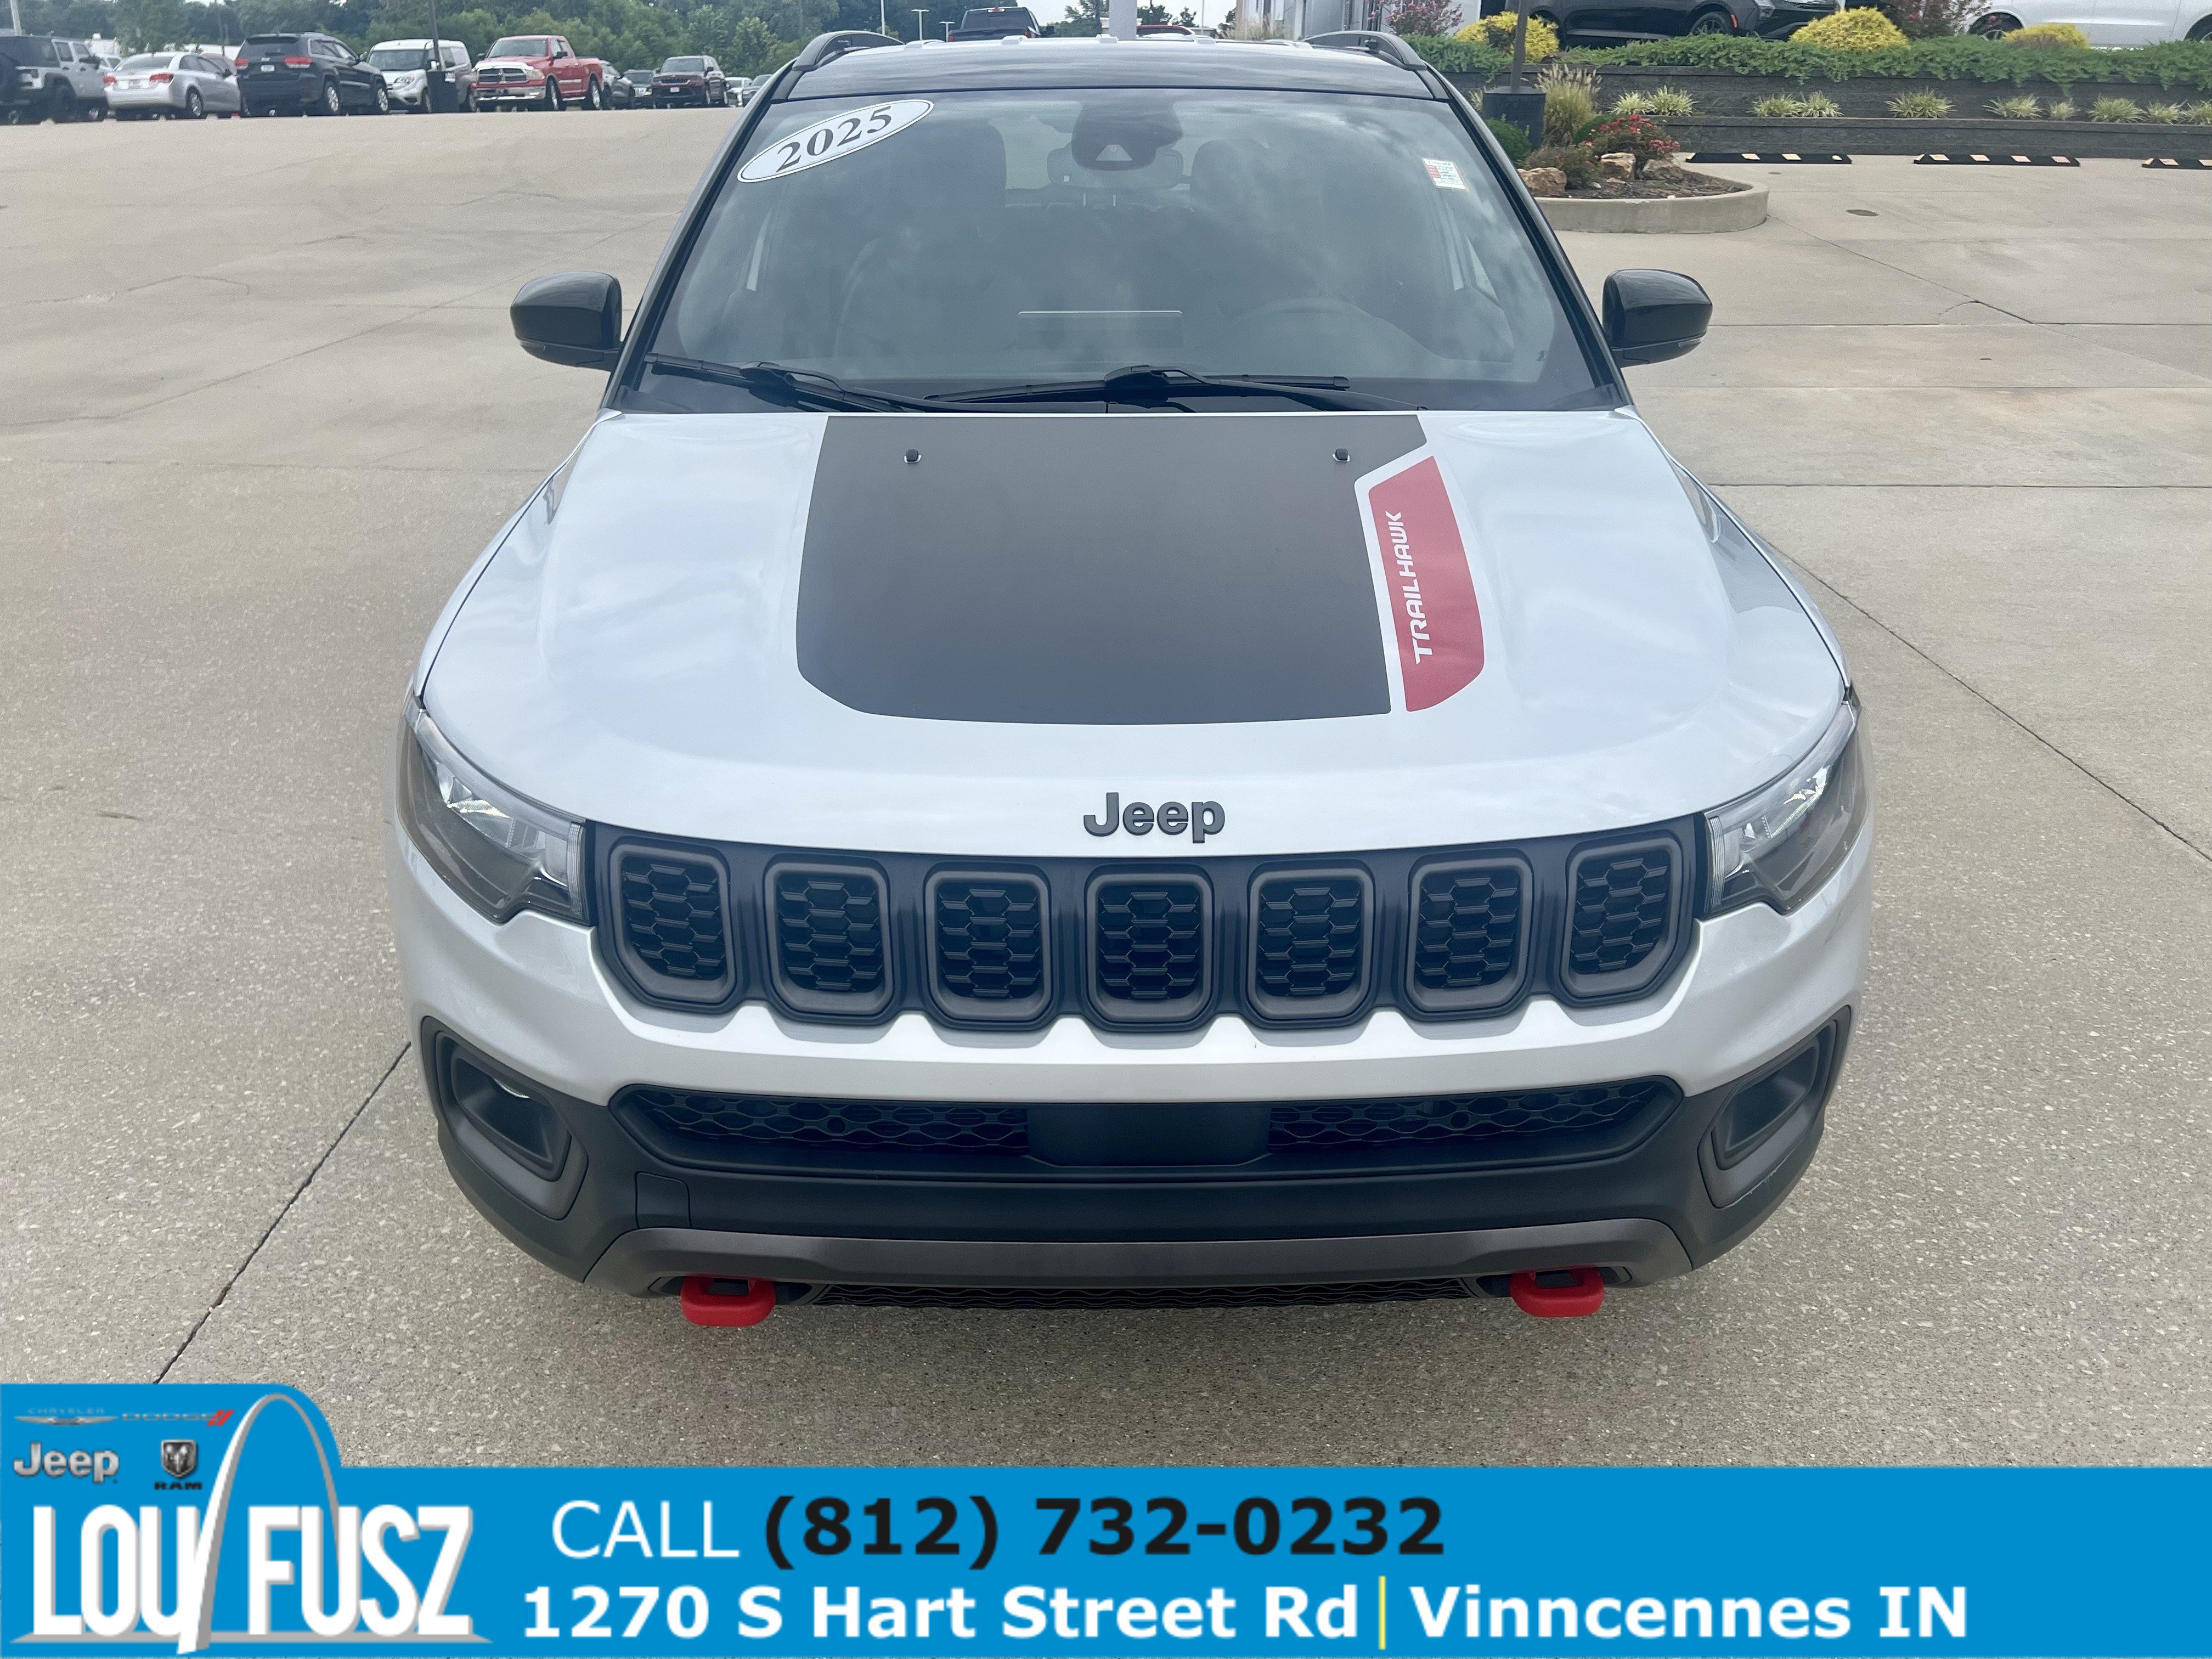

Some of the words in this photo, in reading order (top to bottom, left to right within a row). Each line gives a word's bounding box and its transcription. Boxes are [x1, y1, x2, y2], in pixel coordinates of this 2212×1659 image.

[776, 106, 892, 173] 2025
[1385, 511, 1432, 665] TRAILHAWK
[1084, 792, 1225, 843] Jeep
